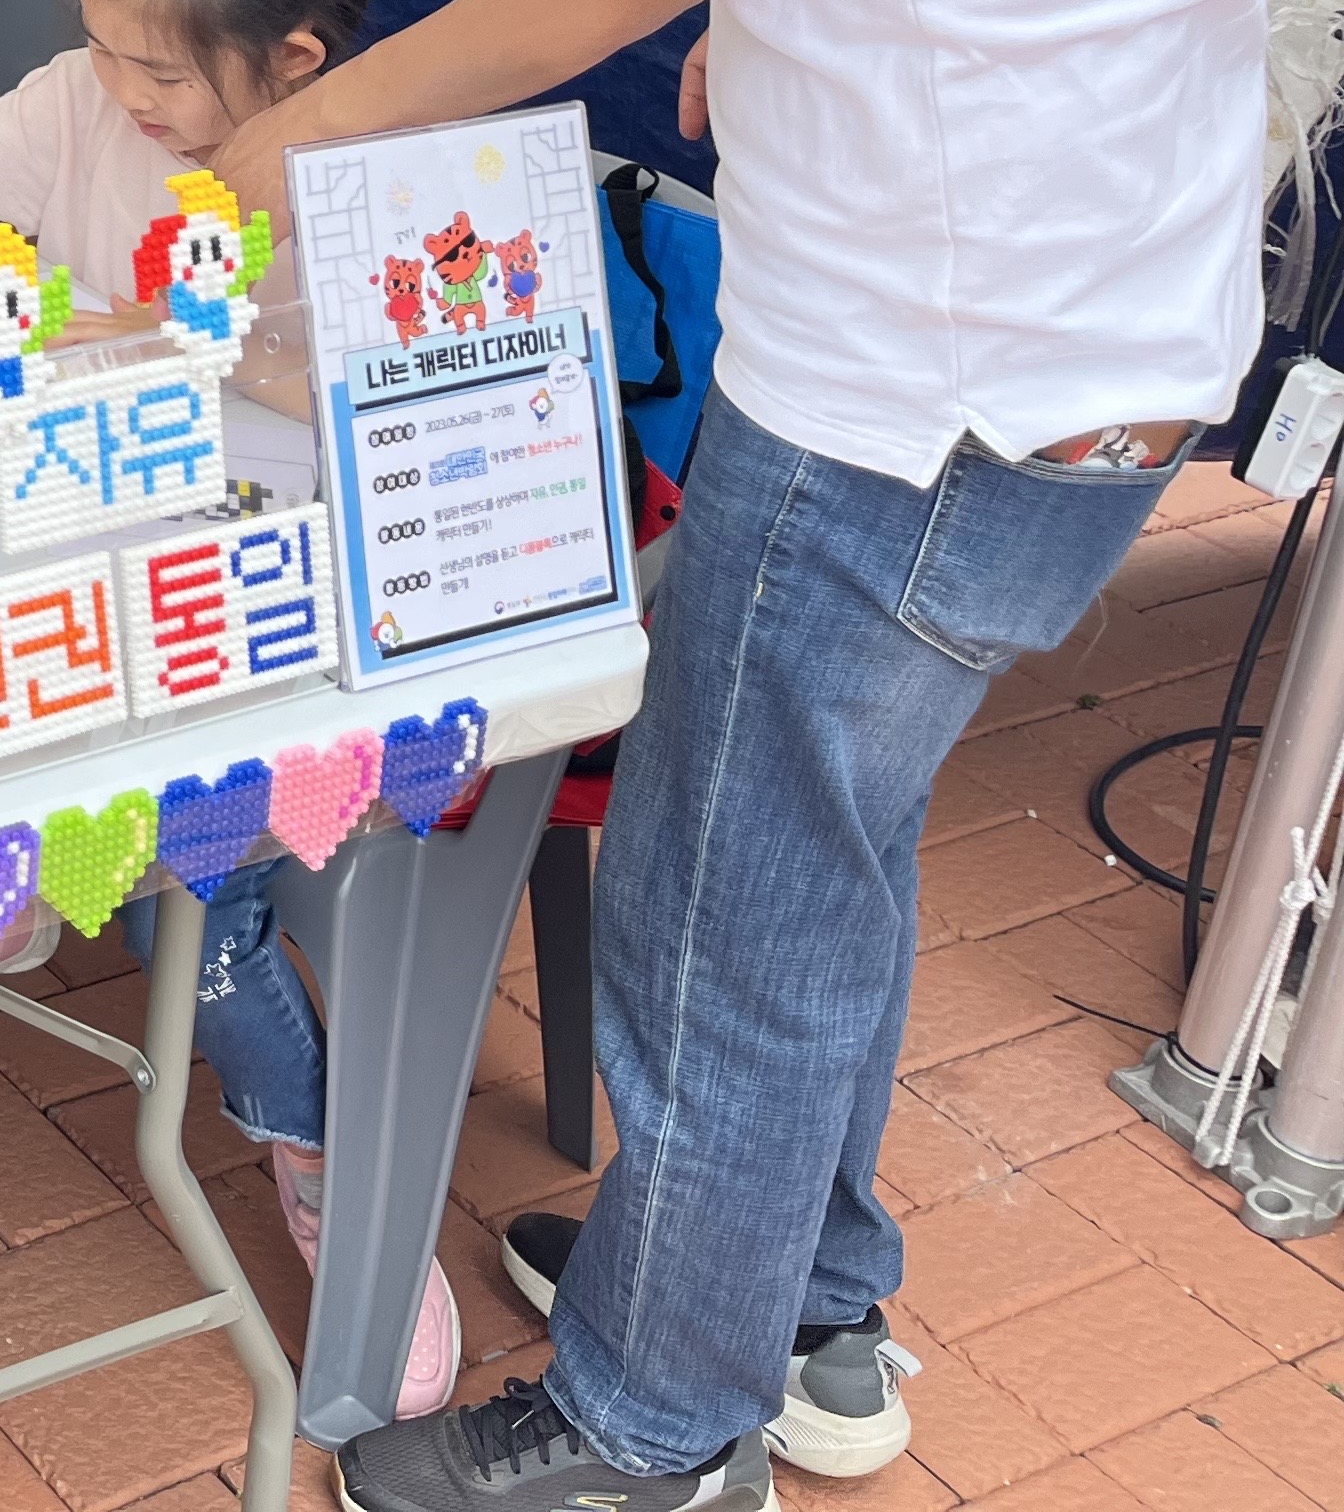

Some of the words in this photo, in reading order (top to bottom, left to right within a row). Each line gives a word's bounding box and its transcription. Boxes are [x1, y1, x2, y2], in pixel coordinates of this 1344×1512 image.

[366, 357, 410, 390] 나는
[412, 341, 478, 379] 캐릭터
[482, 323, 567, 365] 디자이너
[16, 381, 214, 506] 자유
[148, 521, 320, 697] 통일
